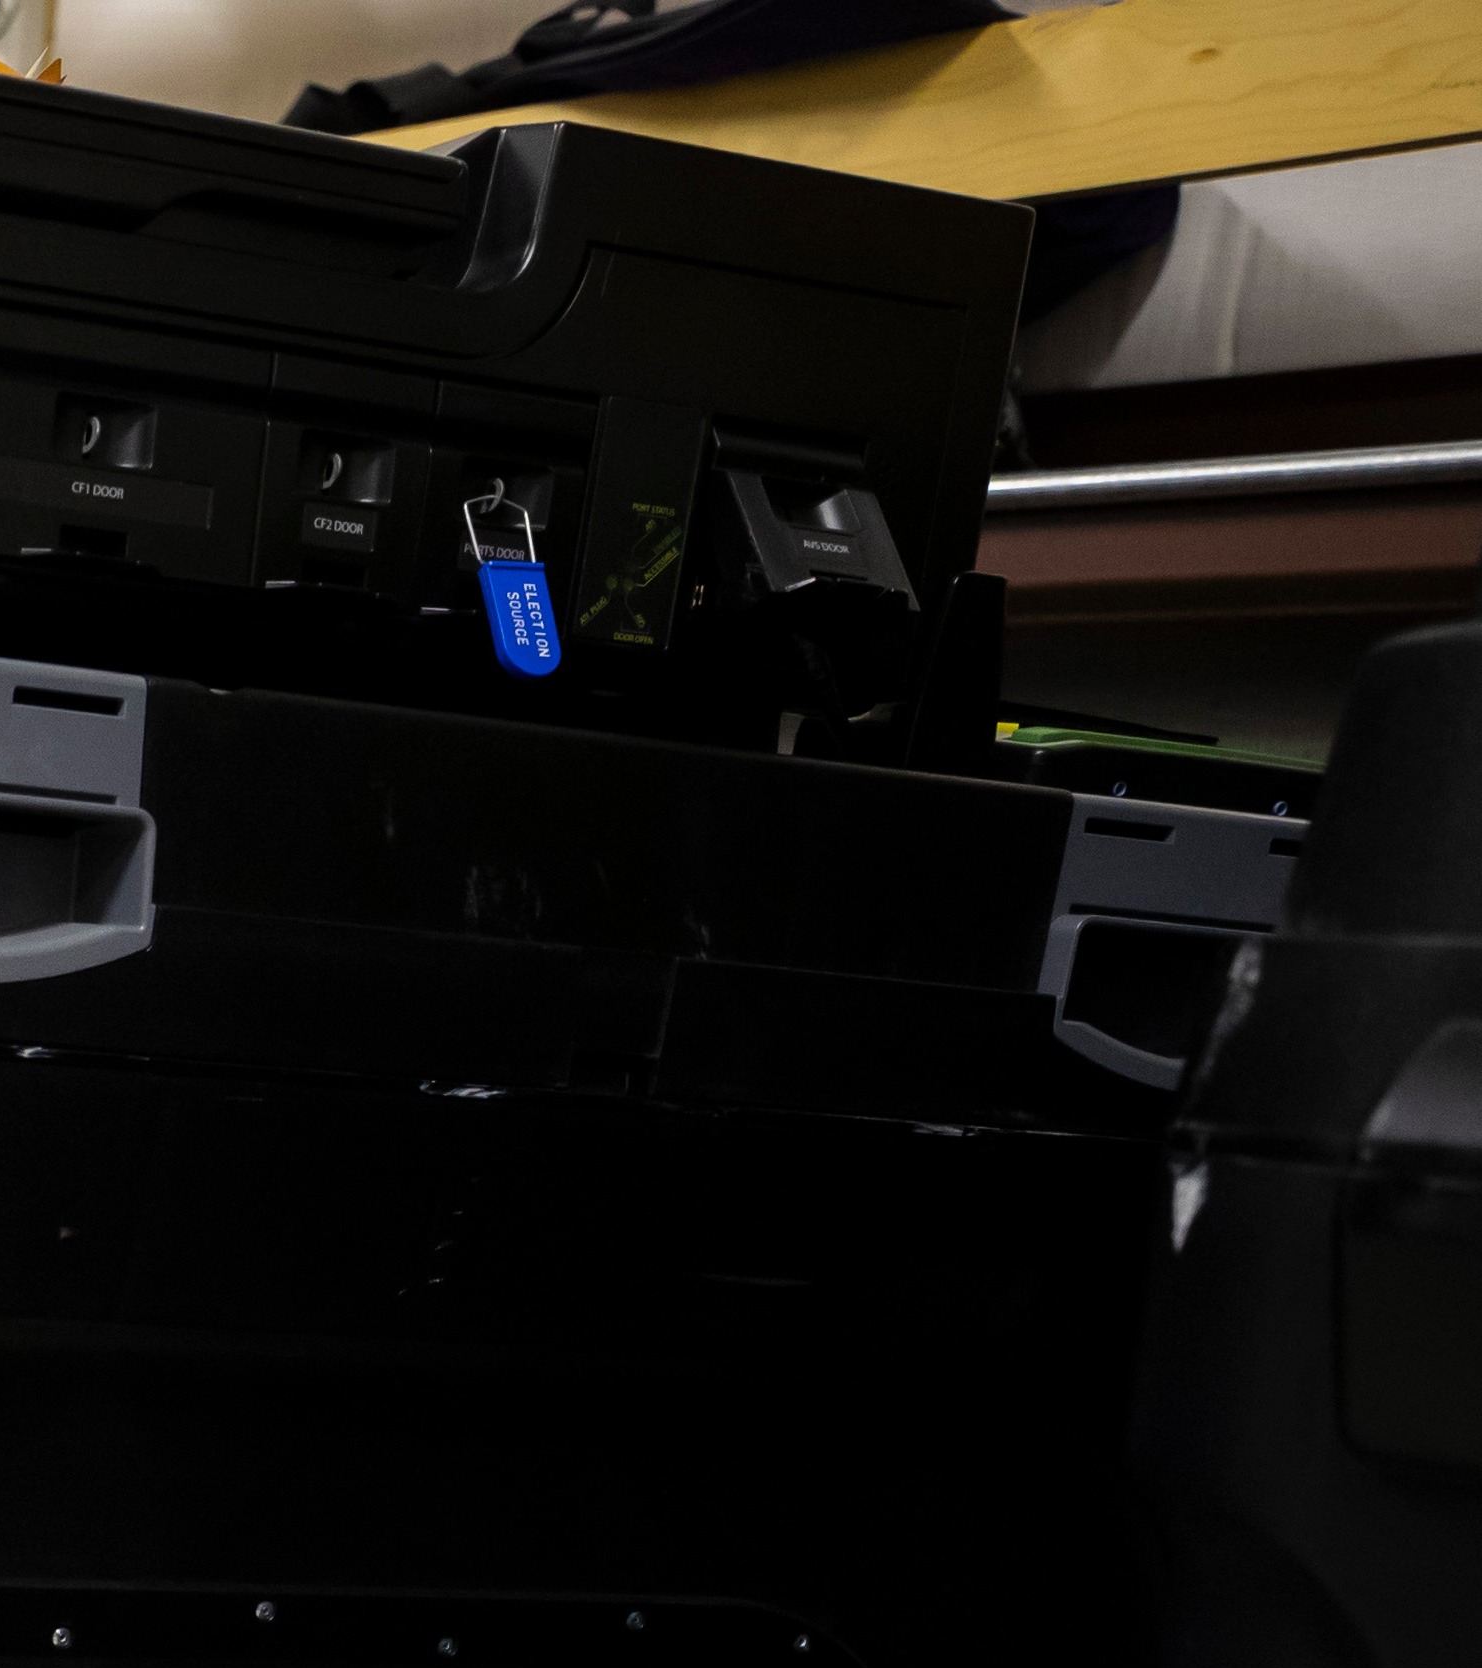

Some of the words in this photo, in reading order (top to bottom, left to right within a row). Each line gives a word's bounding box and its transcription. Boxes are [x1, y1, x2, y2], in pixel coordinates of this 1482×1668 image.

[71, 481, 90, 495] CF1
[92, 484, 124, 499] DOOR
[632, 502, 650, 513] PORT
[651, 505, 676, 517] STATUS
[313, 517, 333, 530] CF2
[334, 520, 364, 535] DOOR
[495, 547, 525, 560] DOOR
[820, 542, 850, 554] DOOR
[507, 592, 530, 646] SOURCE
[523, 583, 551, 658] ELECTION
[613, 631, 634, 642] DOOR
[635, 634, 654, 645] OPEN
